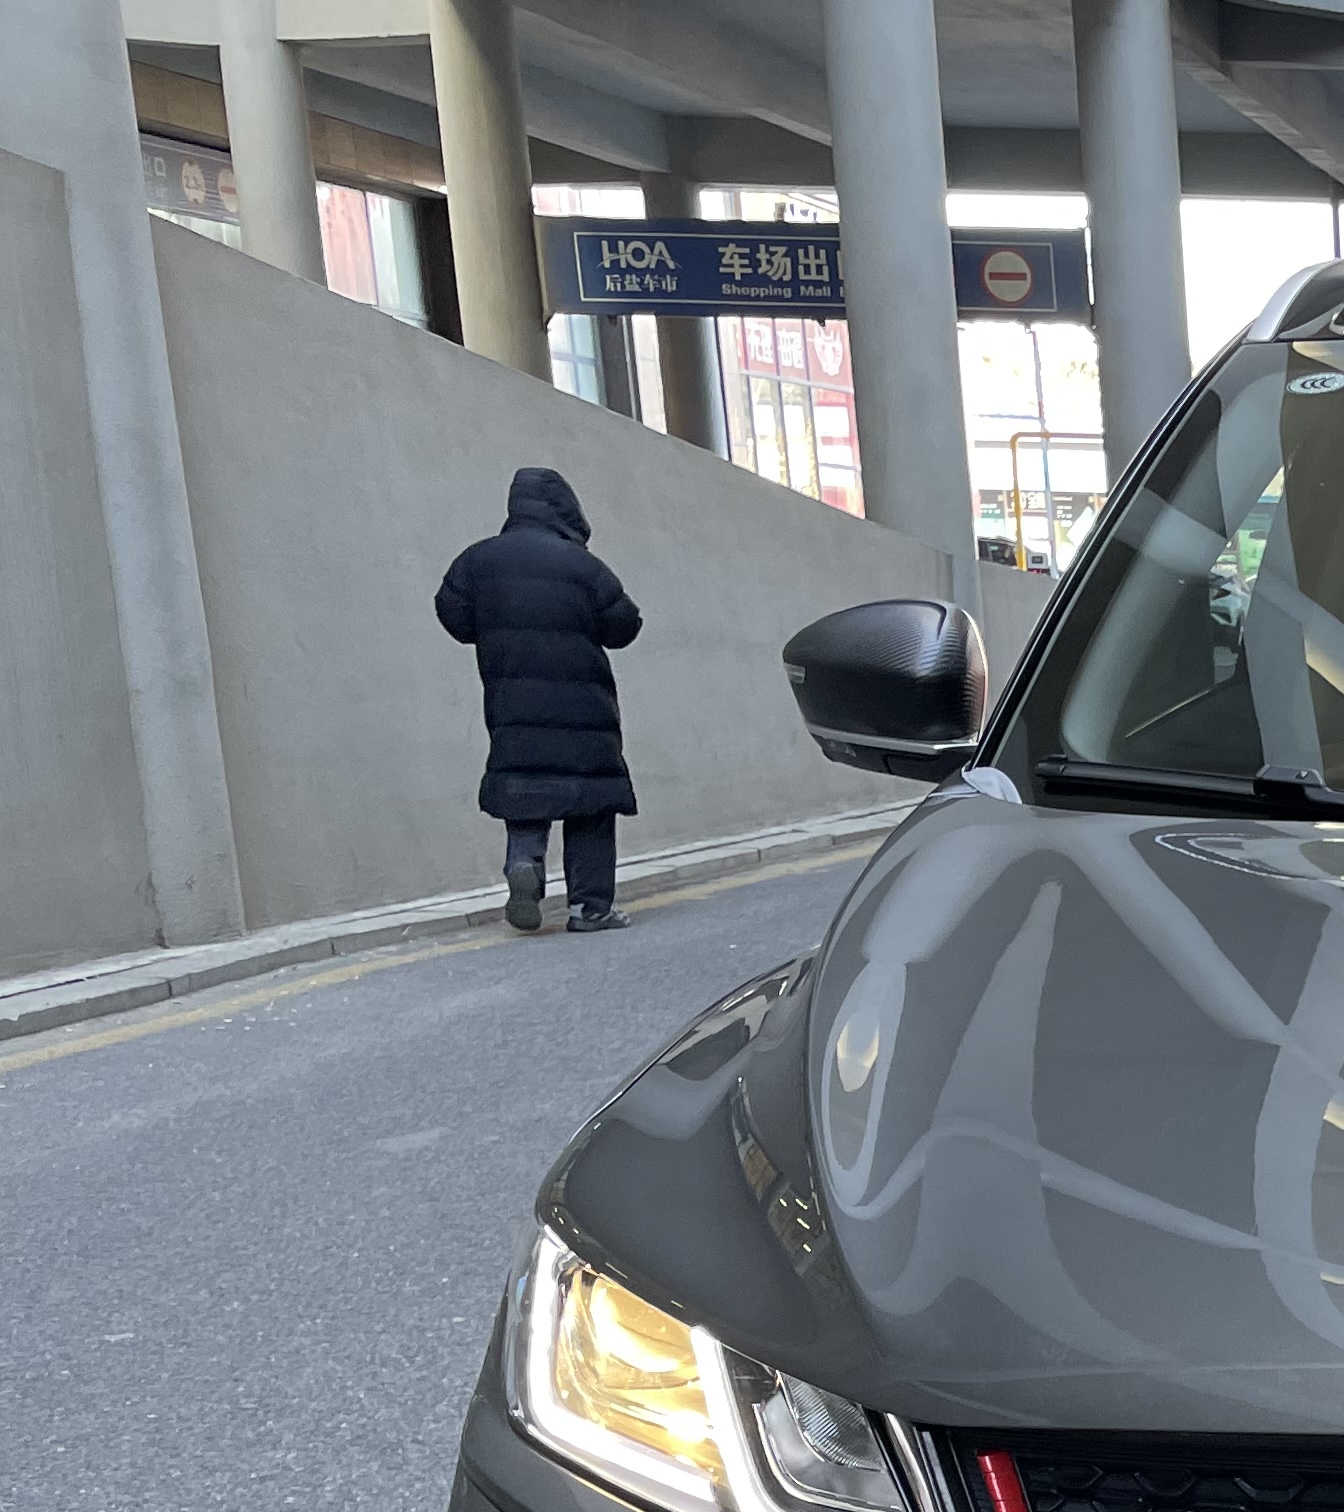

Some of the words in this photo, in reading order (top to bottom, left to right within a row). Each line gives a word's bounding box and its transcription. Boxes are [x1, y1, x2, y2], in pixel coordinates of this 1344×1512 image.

[601, 240, 675, 269] HOA
[718, 243, 844, 282] 车场出
[605, 273, 678, 293] 后盐车市
[721, 283, 792, 298] Shopping
[800, 285, 831, 297] Mall
